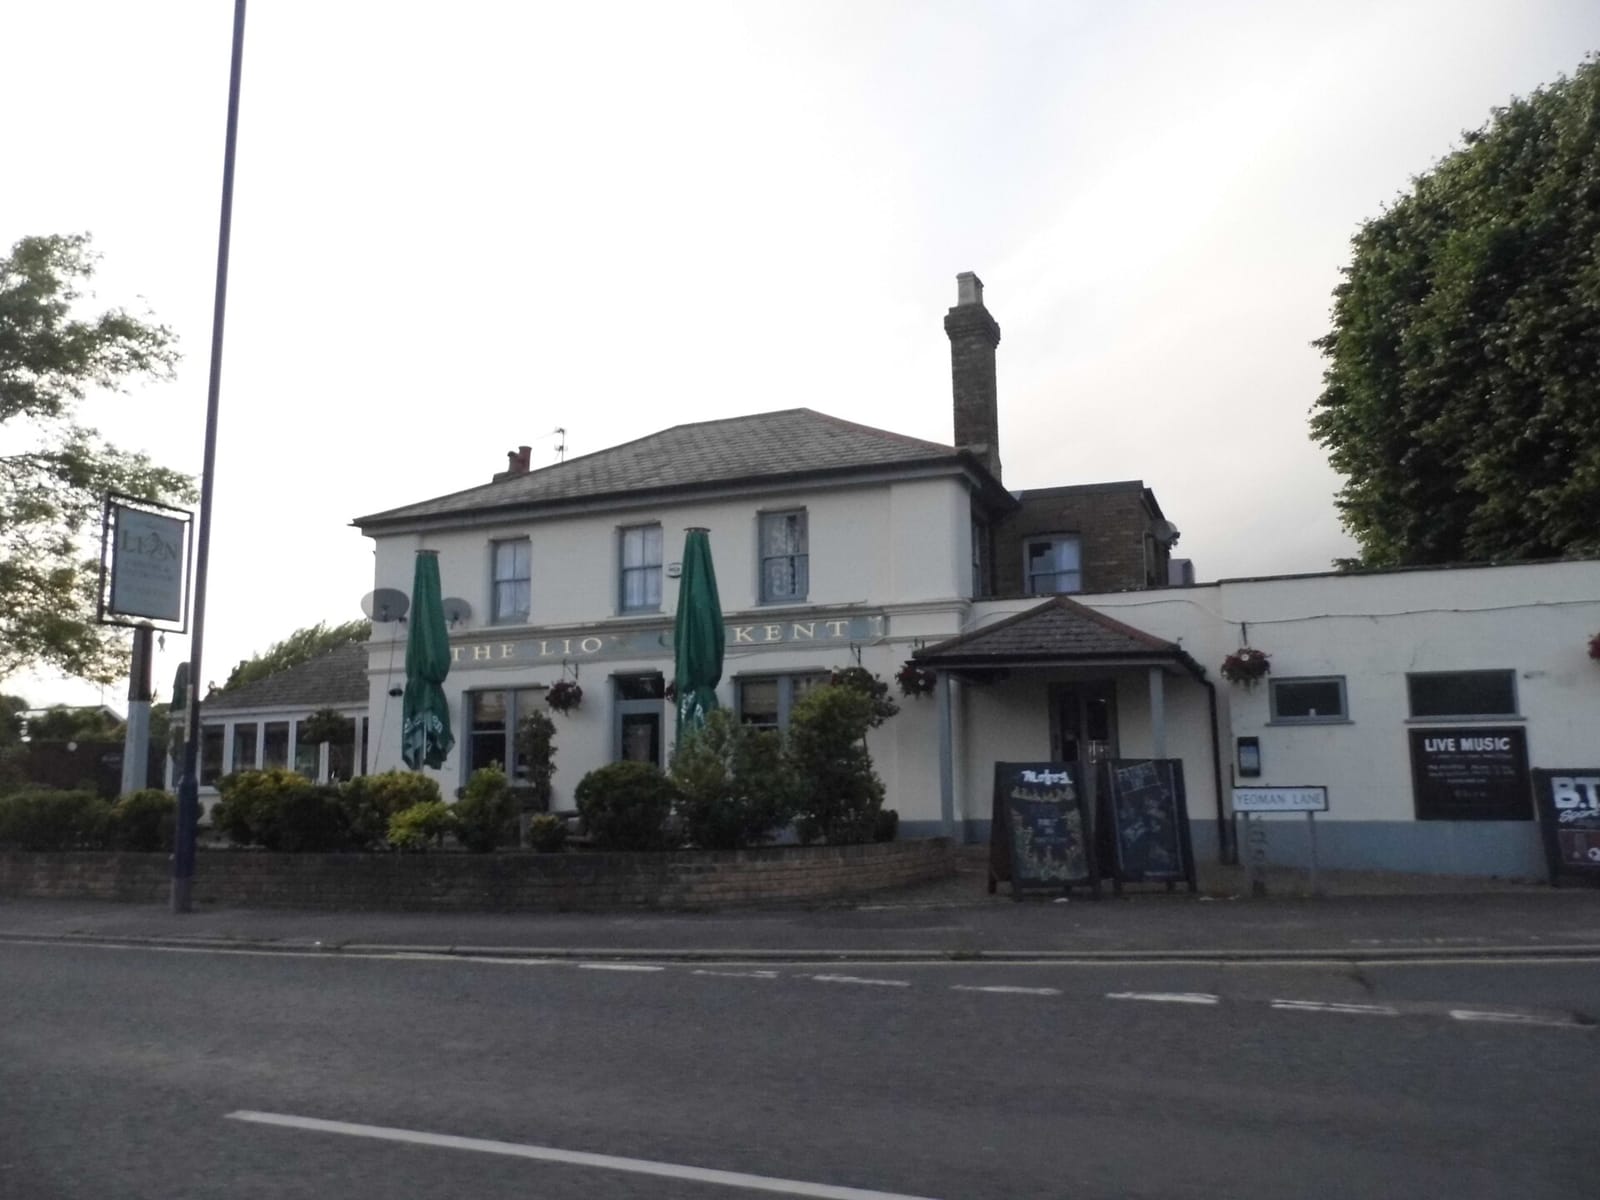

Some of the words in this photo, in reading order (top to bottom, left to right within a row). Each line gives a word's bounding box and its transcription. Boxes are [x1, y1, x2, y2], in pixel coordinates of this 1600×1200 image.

[451, 644, 515, 662] THE
[540, 636, 616, 656] LIO
[733, 620, 849, 643] KENT
[1424, 738, 1456, 752] LIVE
[1460, 737, 1511, 752] MUSIC
[1236, 793, 1287, 805] YEOMAN
[1292, 792, 1322, 805] LANE
